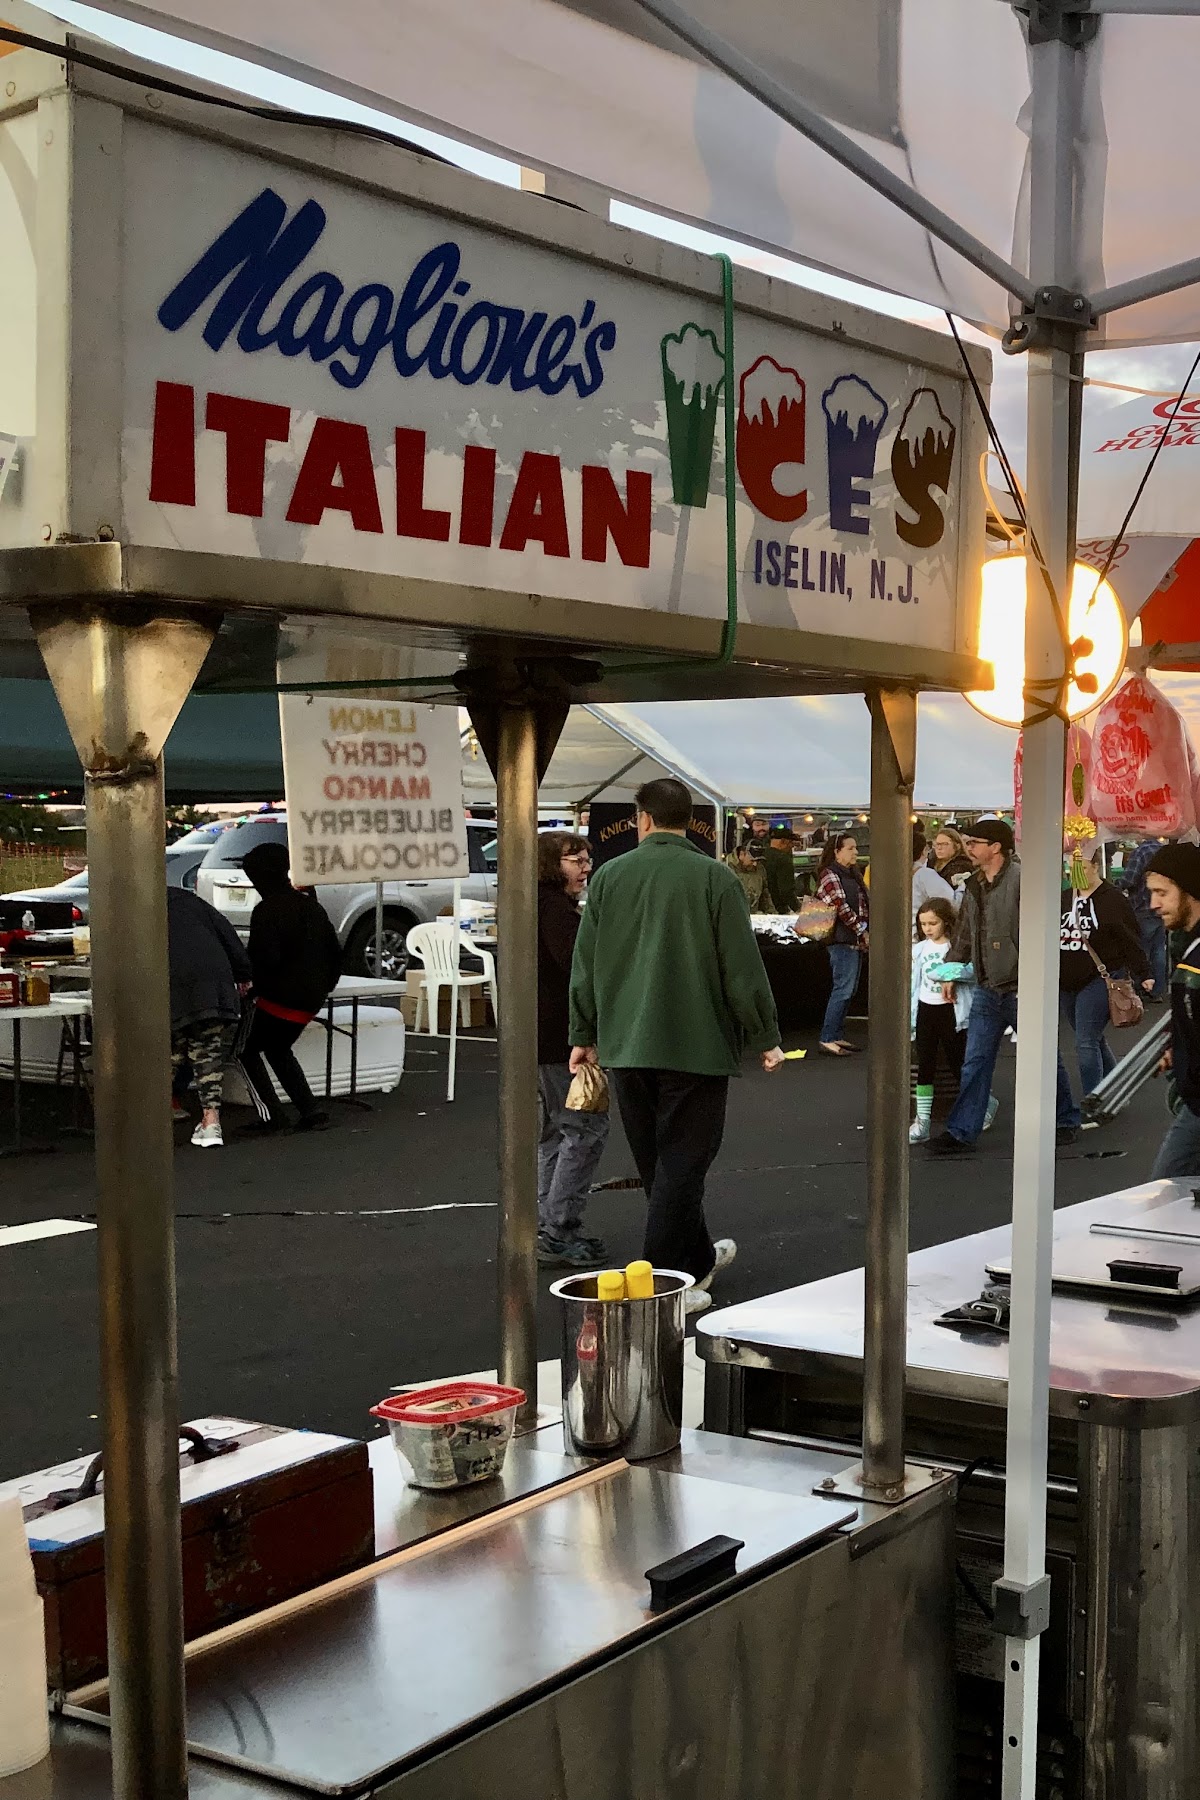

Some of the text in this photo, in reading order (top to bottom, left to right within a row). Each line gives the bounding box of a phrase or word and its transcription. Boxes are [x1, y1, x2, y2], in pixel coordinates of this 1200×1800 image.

[157, 188, 616, 398] Maglione's
[149, 322, 955, 568] ITALIAN ICES
[754, 538, 920, 605] ISELIN, N.J.
